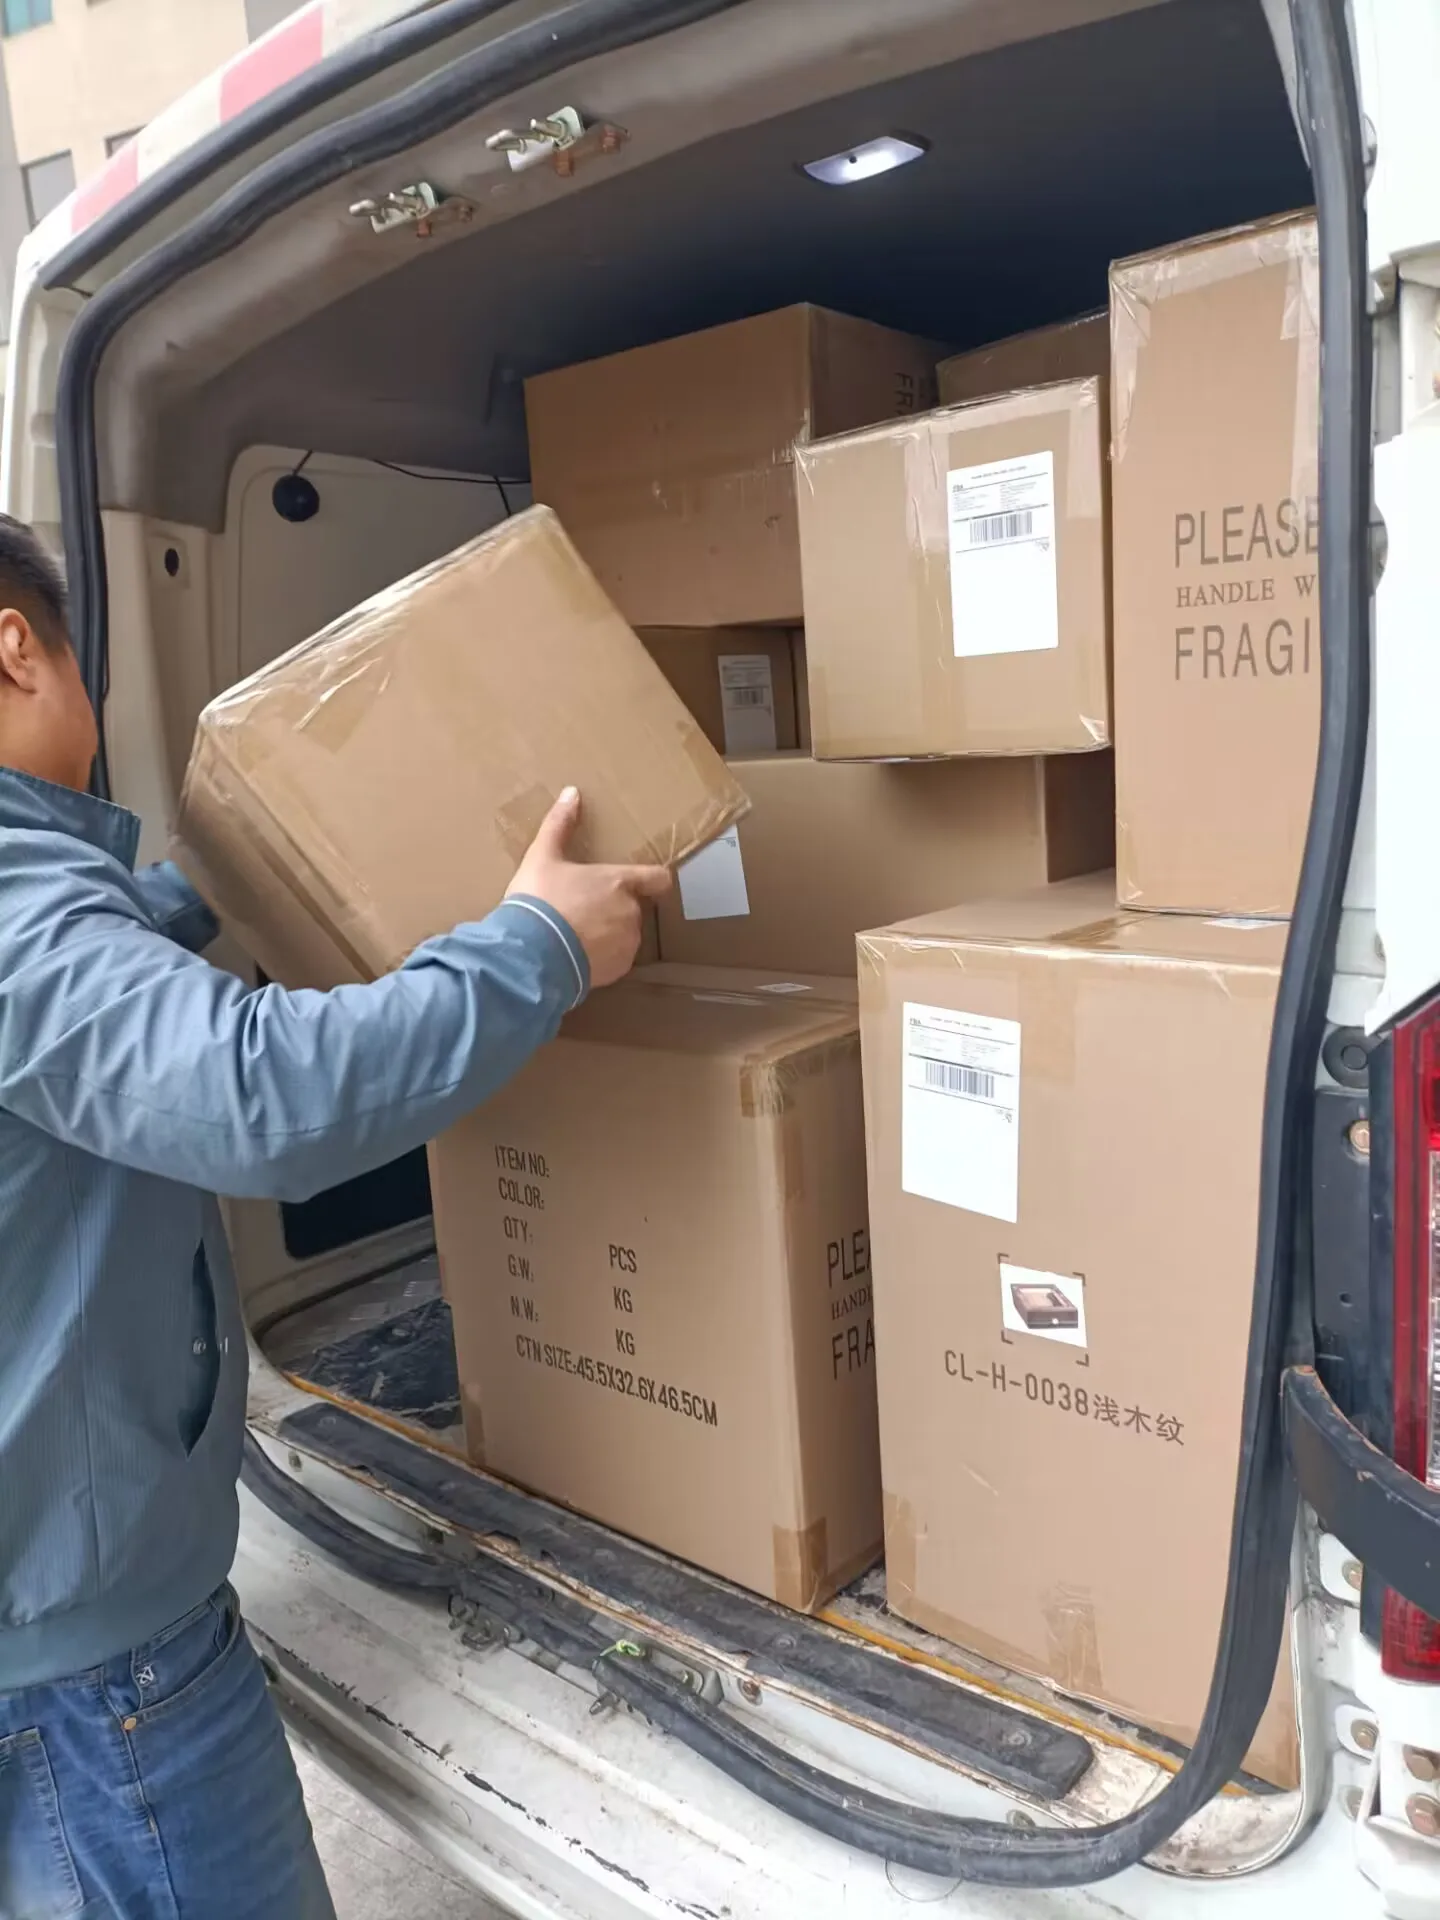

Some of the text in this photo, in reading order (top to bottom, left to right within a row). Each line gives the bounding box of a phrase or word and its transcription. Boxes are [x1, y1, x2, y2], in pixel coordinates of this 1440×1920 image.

[1176, 578, 1275, 608] HANDLE
[495, 1145, 551, 1179] ITEM NO:
[498, 1177, 545, 1210] COLOR:
[608, 1244, 637, 1273] PCS
[613, 1286, 633, 1314] KG
[510, 1296, 636, 1357] N.W: KG
[516, 1334, 542, 1364] CTN
